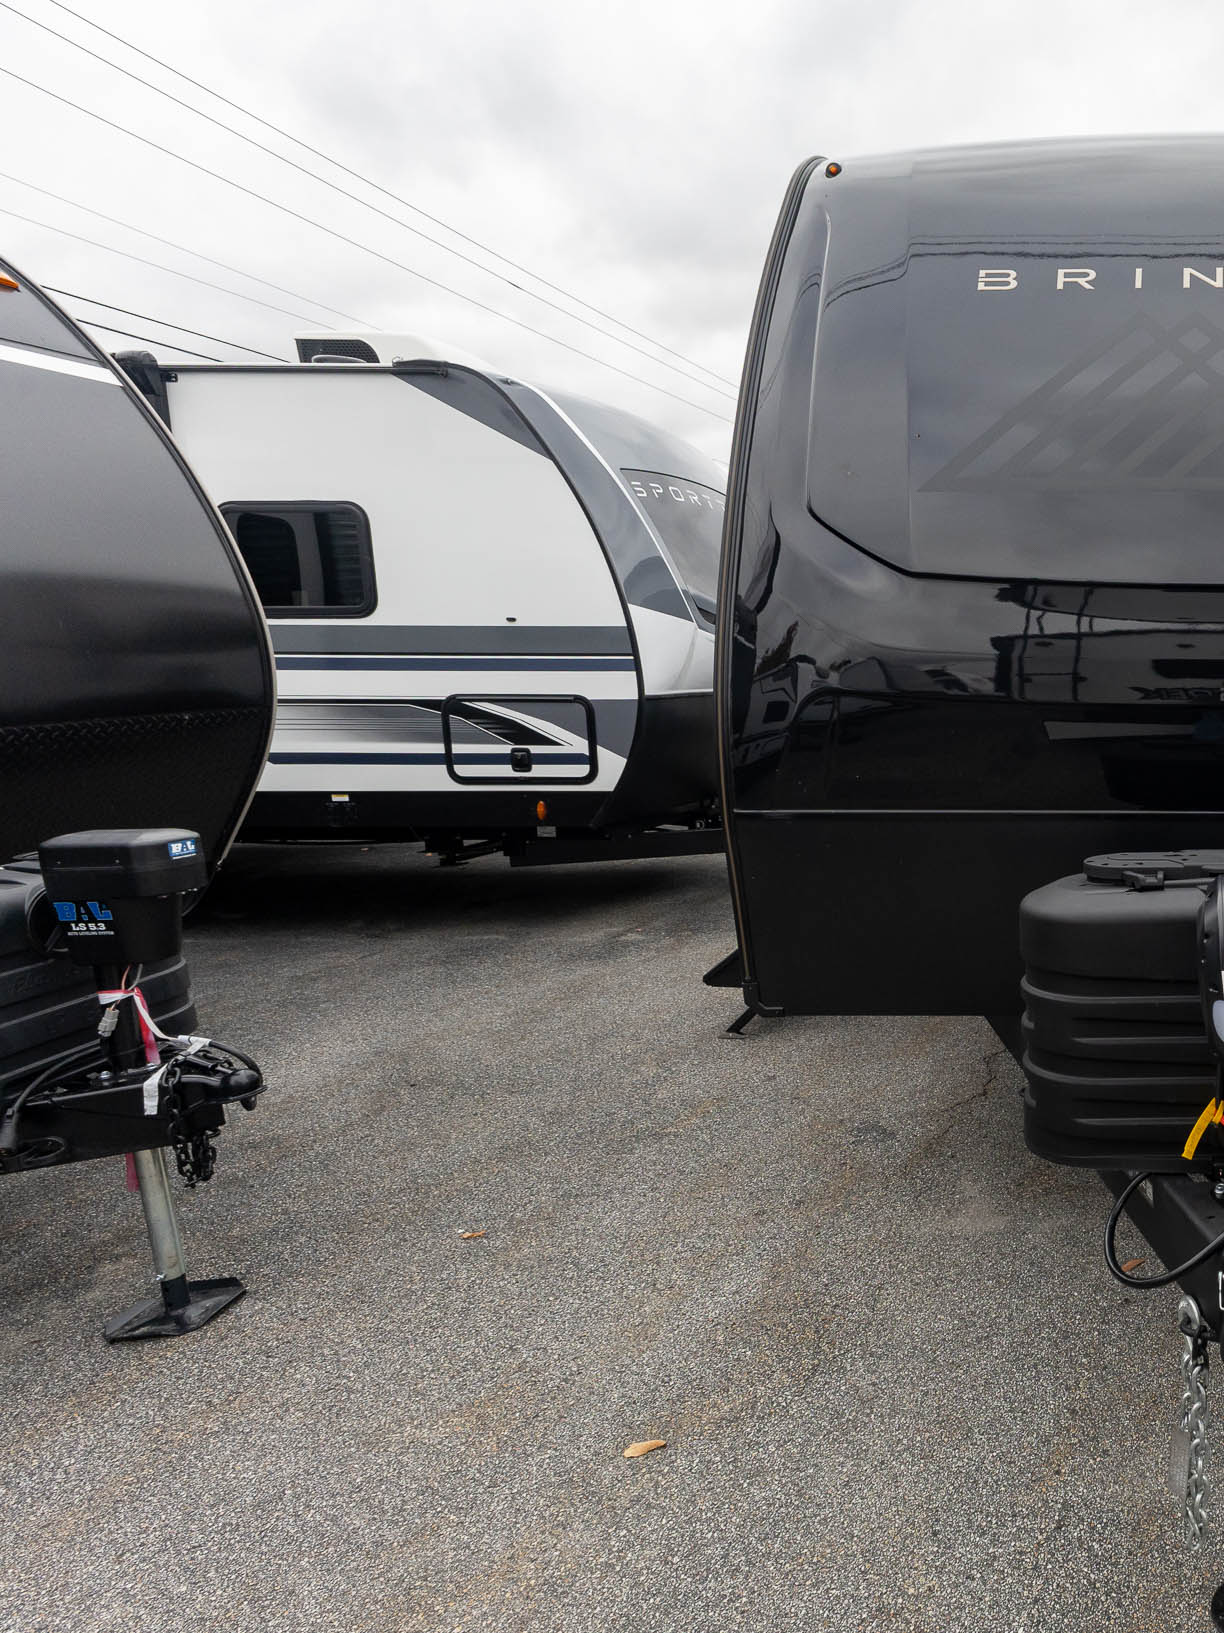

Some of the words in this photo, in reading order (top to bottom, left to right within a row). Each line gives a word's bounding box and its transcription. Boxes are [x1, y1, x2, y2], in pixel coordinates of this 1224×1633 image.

[52, 901, 114, 921] BAL
[70, 922, 88, 931] LS
[88, 922, 106, 931] 5.3
